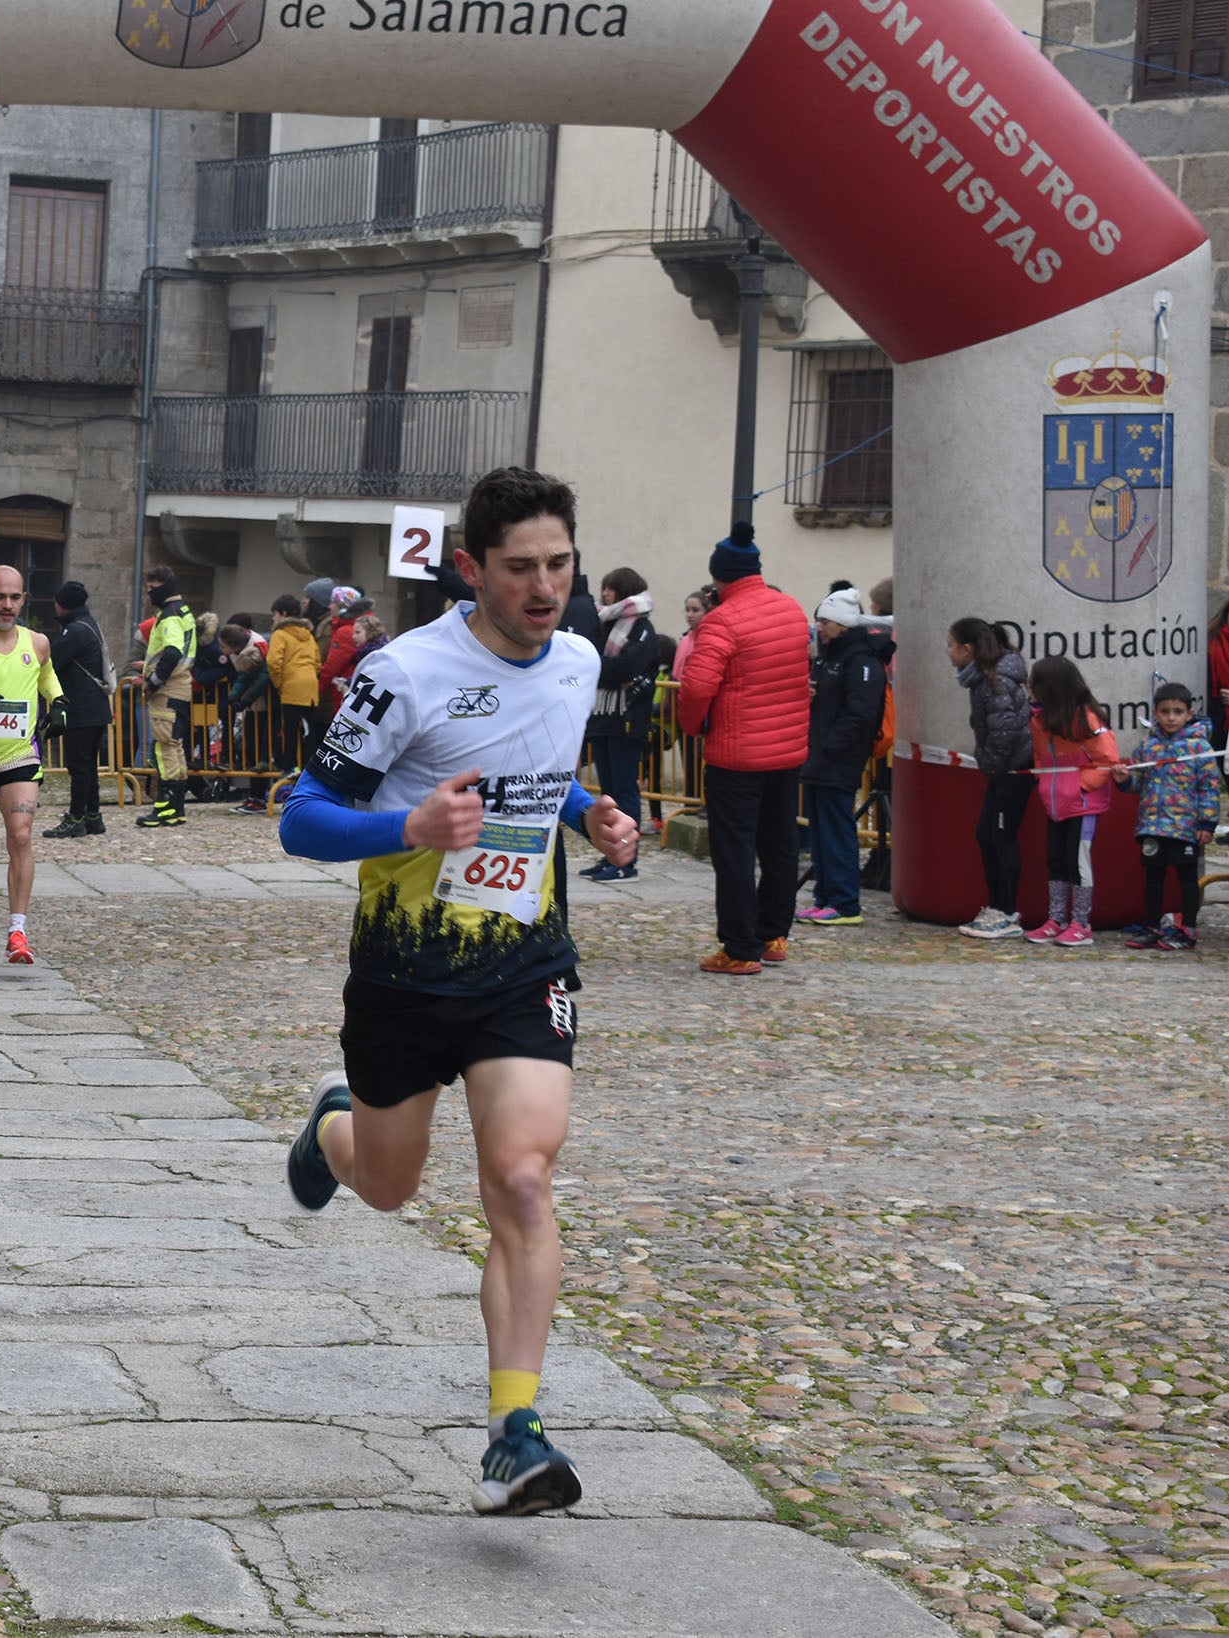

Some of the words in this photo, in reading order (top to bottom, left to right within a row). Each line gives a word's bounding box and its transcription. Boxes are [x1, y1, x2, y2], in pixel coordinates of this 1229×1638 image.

[348, 0, 628, 38] Salamanca
[799, 11, 1062, 284] DEPORTISTAS
[917, 39, 1122, 256] NUESTROS
[400, 527, 431, 565] 2
[464, 852, 529, 891] 625
